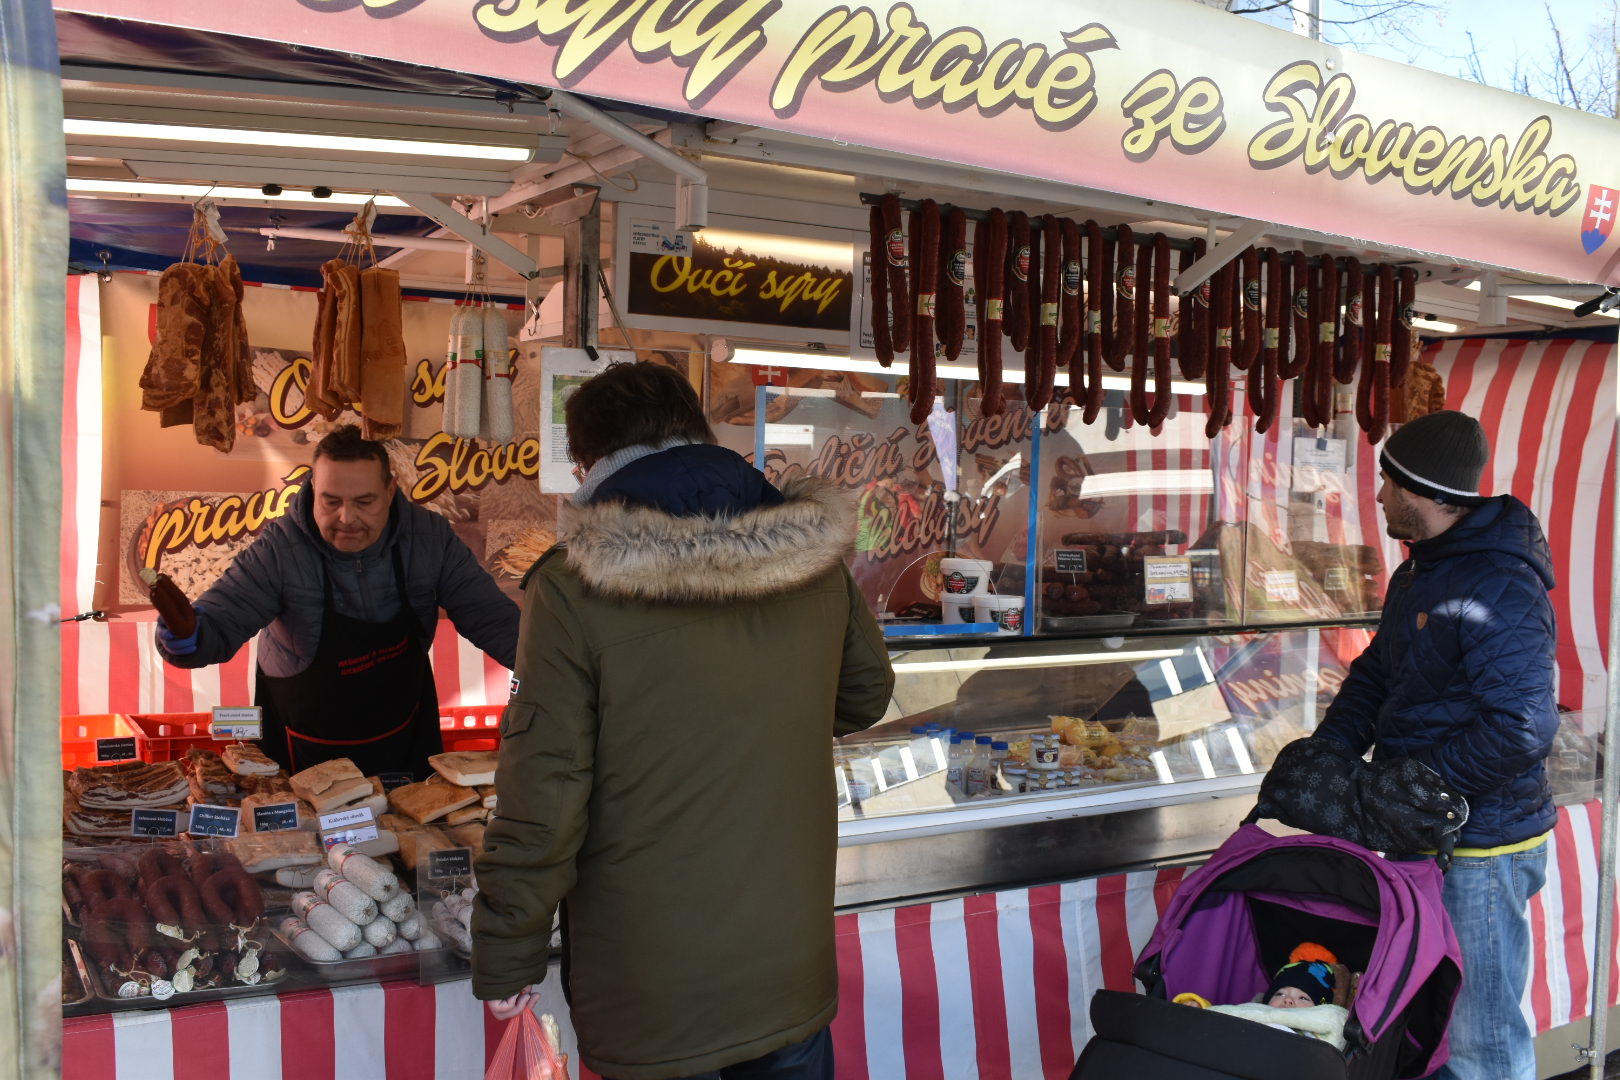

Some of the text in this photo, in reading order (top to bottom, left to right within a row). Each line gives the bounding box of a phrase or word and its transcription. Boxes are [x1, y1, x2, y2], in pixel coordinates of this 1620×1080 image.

[769, 1, 1119, 132] pravé
[1121, 68, 1226, 163] ze
[1247, 59, 1581, 217] Slovenska
[650, 255, 843, 315] Ovčí syry
[411, 430, 540, 503] Slove
